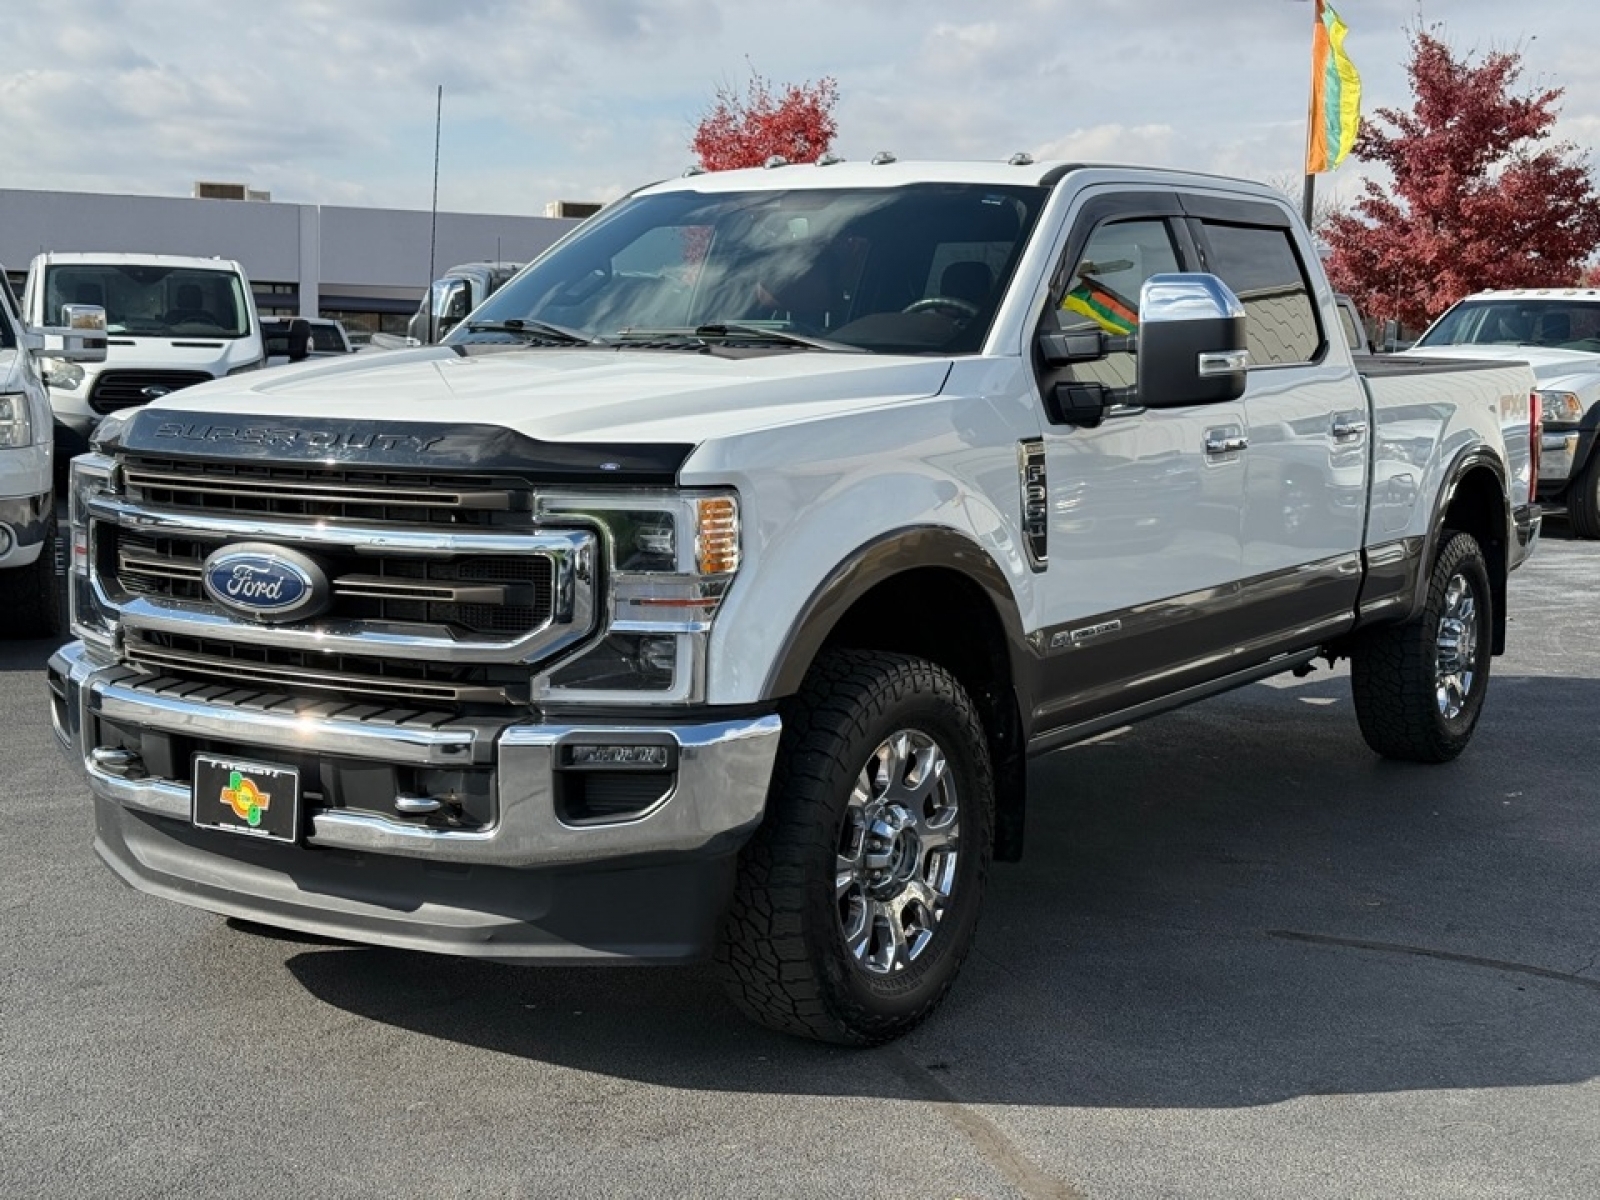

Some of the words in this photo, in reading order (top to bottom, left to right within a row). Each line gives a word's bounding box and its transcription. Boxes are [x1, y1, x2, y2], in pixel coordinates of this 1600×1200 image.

[155, 423, 299, 447] SUPER
[308, 430, 446, 452] DUTY
[226, 564, 284, 599] Ford
